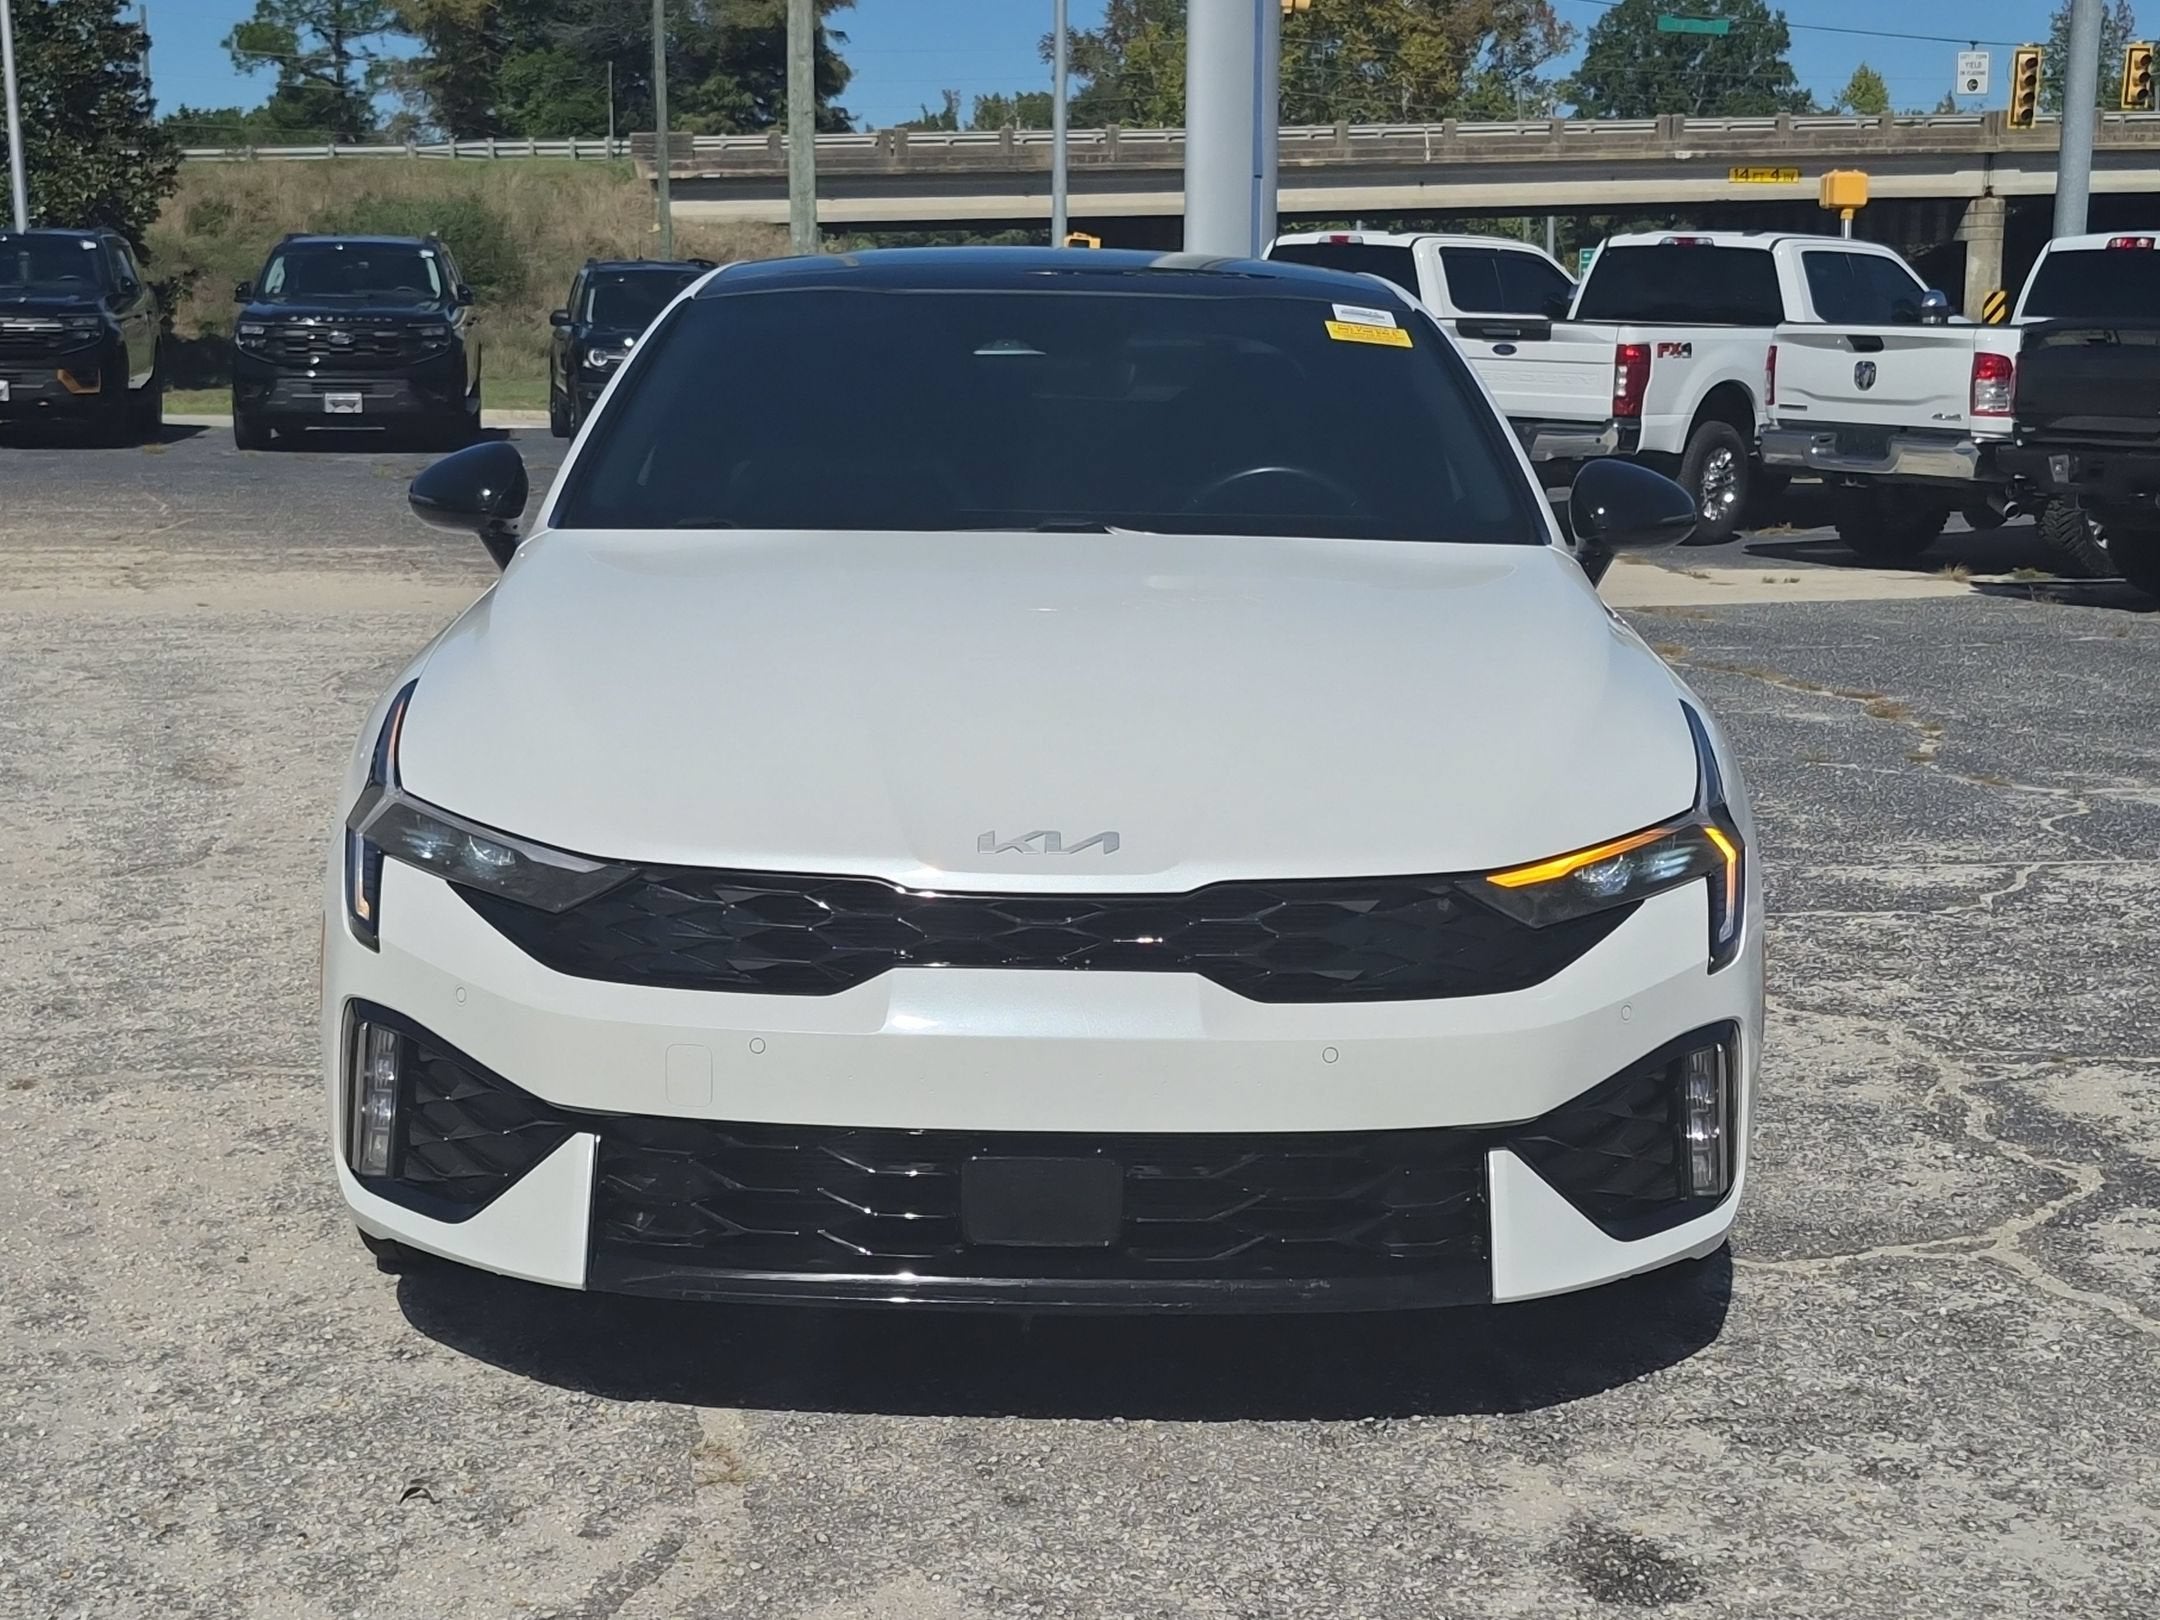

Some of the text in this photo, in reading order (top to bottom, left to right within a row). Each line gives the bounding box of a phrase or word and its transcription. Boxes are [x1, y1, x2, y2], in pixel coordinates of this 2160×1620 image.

[1965, 61, 1982, 69] YIELD
[1734, 168, 1749, 181] 14
[1752, 172, 1765, 181] FT
[1770, 168, 1779, 182] 4
[1657, 342, 1692, 358] FX4
[977, 830, 1120, 855] KIA
